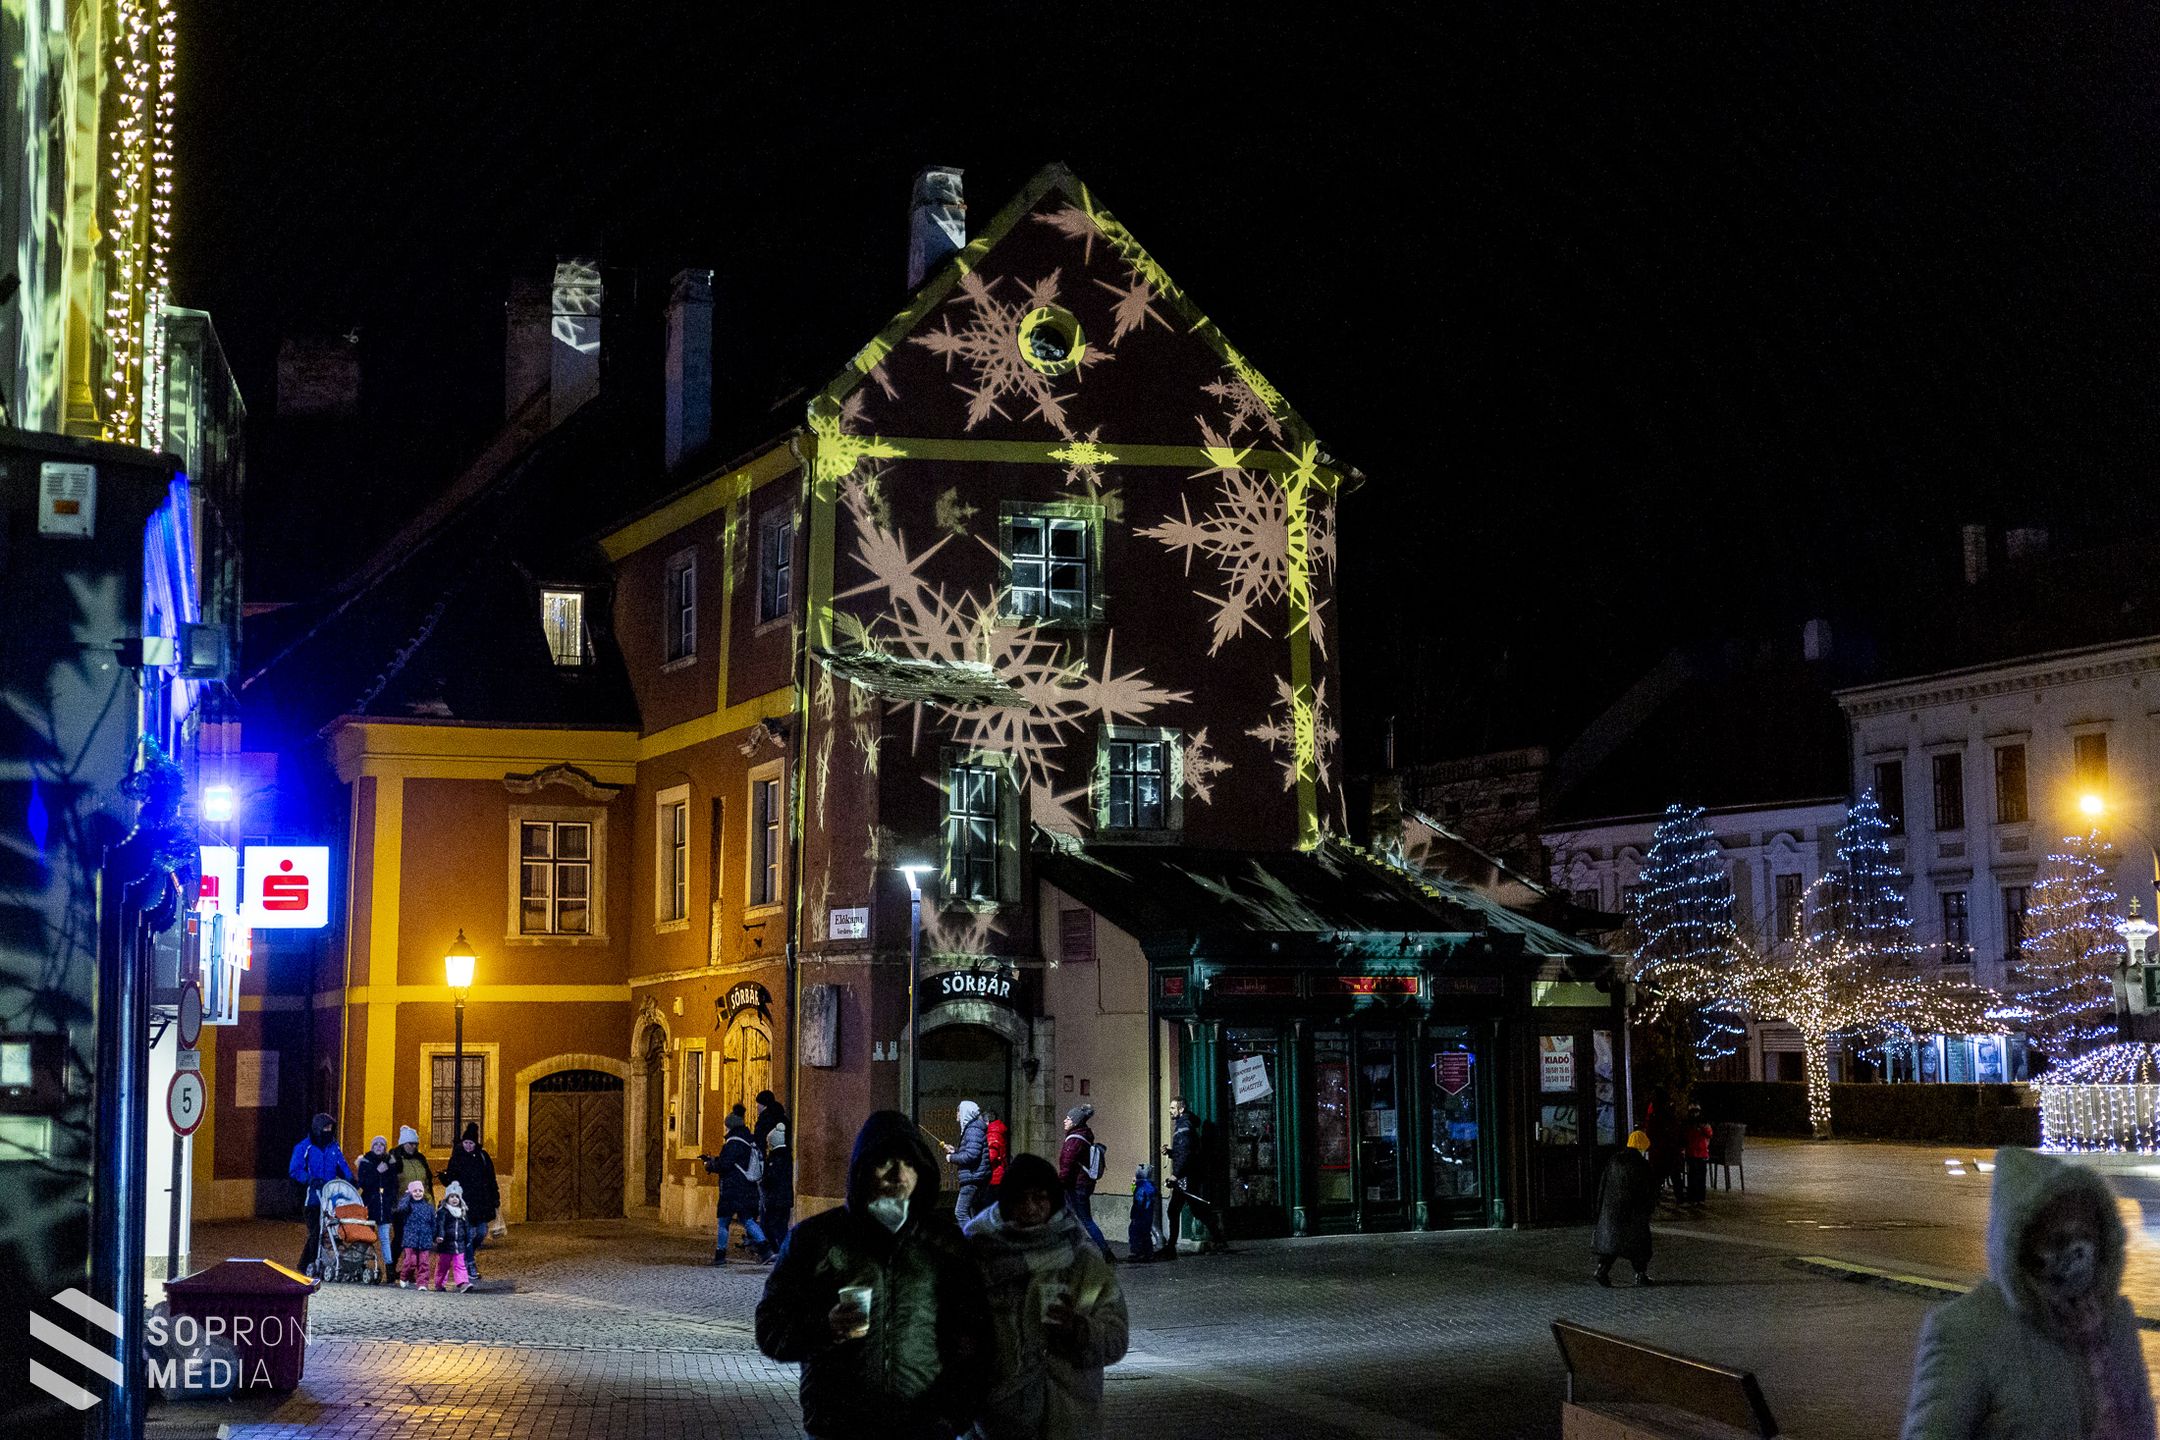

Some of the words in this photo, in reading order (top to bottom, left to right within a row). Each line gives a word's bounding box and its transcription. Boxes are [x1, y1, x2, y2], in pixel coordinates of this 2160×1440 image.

[835, 914, 863, 926] Előkapu
[730, 984, 760, 1010] SÖRBÁR
[942, 971, 1010, 998] SÖRBÁR
[1545, 1054, 1569, 1064] KIADÓ
[182, 1087, 192, 1114] 5
